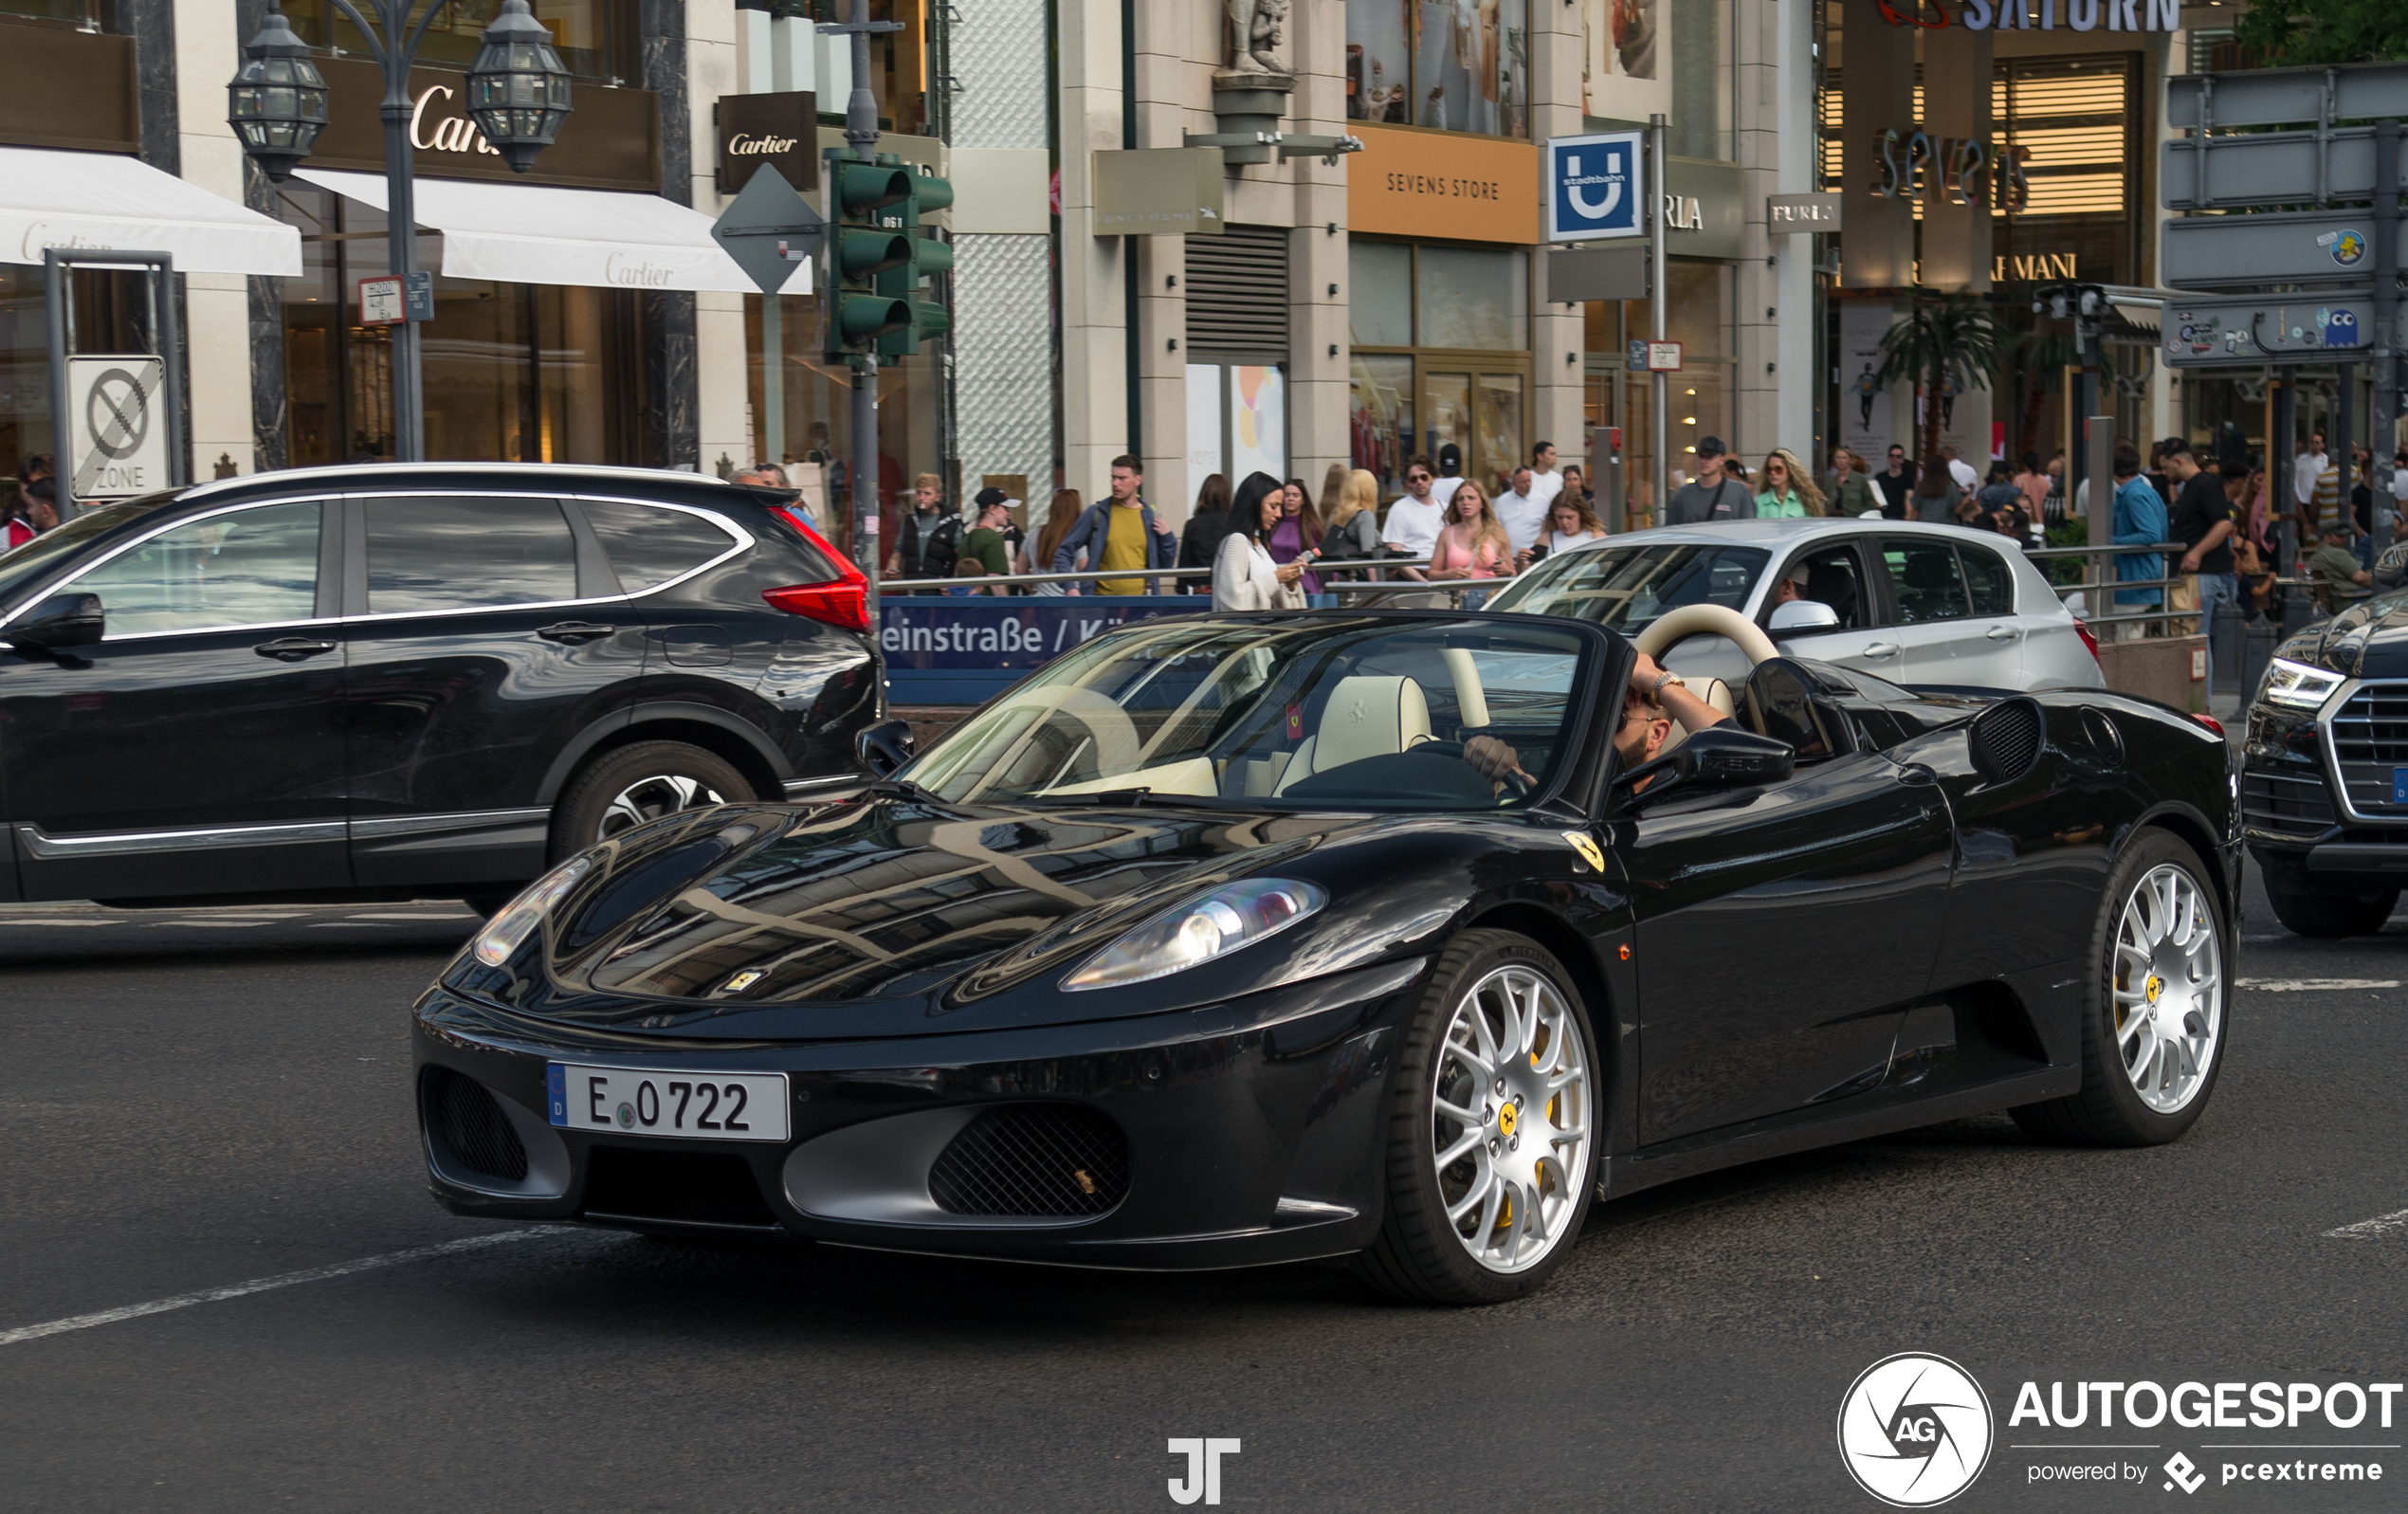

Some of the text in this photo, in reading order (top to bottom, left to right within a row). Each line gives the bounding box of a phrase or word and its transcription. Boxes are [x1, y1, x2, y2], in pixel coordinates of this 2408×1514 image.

[728, 133, 797, 156] Cartier
[1562, 173, 1626, 186] stadtbahn
[1871, 127, 2029, 213] sevens
[1387, 173, 1499, 201] SEVENS STORE
[1096, 210, 1194, 225] LONGCHAMP
[1665, 194, 1704, 230] RLA
[1772, 204, 1836, 222] FURLA
[605, 250, 675, 286] Cartier
[96, 466, 146, 489] ZONE
[881, 617, 1043, 653] einstraße
[554, 1102, 562, 1117] D
